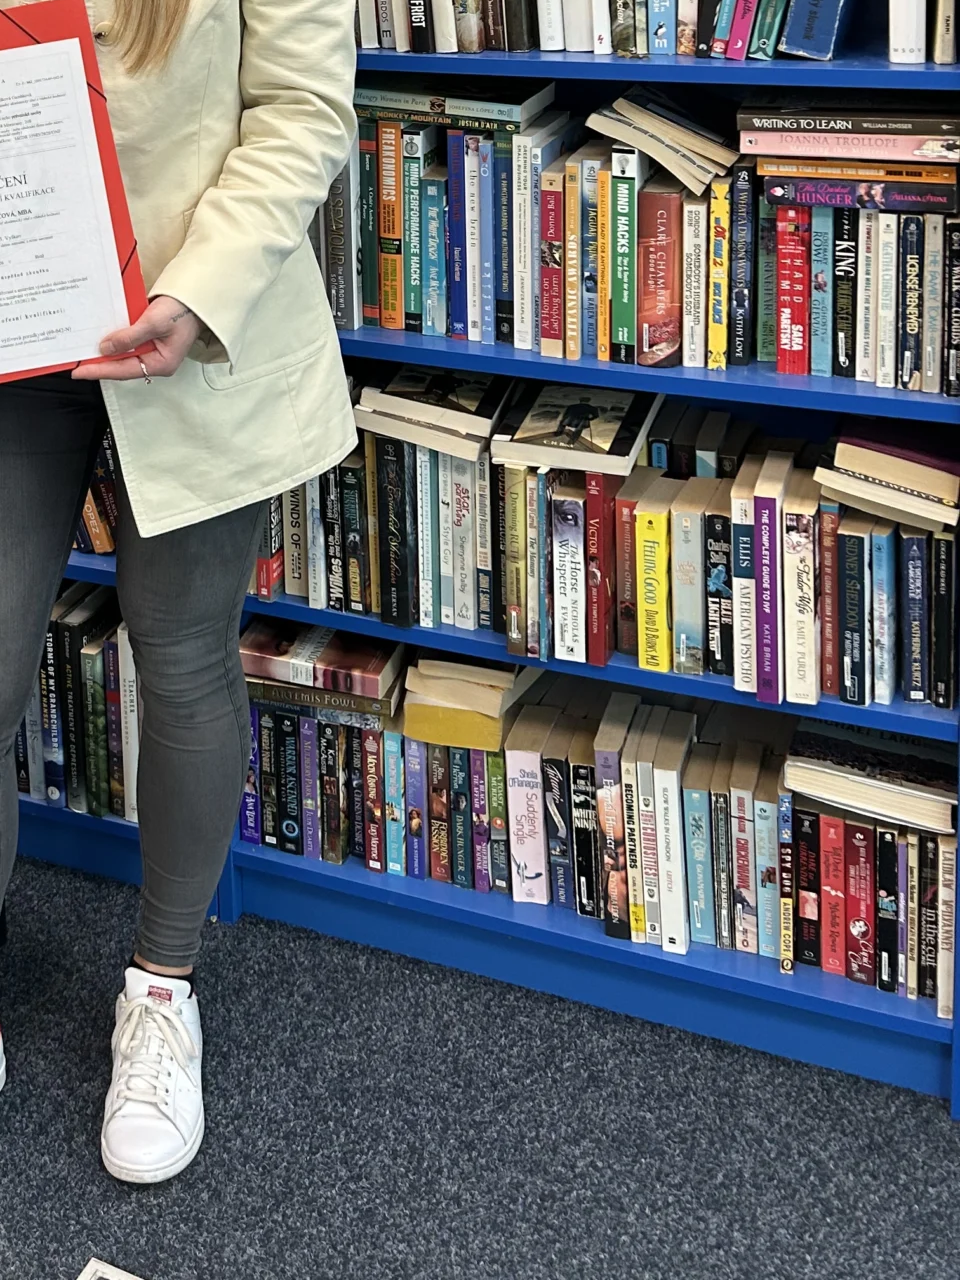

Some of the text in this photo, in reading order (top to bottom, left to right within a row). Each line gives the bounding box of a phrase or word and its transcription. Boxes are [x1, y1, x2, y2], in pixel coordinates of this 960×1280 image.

[377, 112, 451, 124] MONKEY MOUNTAIN
[753, 118, 852, 130] WRITING TO LEARN
[779, 134, 898, 148] JOANNA TROLLOPE
[381, 128, 396, 201] FREAKONOMICS
[5, 187, 55, 201] KVALIFIKACE
[797, 193, 852, 204] HUNGER
[409, 163, 420, 286] MIND PERFORMANCE HACKS
[618, 184, 630, 254] MIND HACKS
[655, 210, 668, 316] CLARE CHAMBERS
[779, 259, 791, 301] TIME
[835, 240, 855, 276] KING
[566, 232, 578, 336] TITANIC AWARDS
[792, 259, 803, 304] HARD
[907, 255, 920, 334] LICENSE RENEWED
[736, 309, 744, 335] KATHY
[780, 308, 791, 351] PARETSKY
[791, 325, 804, 351] SARA
[290, 489, 300, 551] WINDS OF
[588, 519, 600, 554] VICTOR
[557, 539, 581, 597] Horse Whisperer
[644, 540, 660, 578] FEELING
[739, 536, 751, 568] ELLIS
[761, 526, 770, 590] COMPLETE GUIDE
[331, 556, 342, 601] Wilkes
[844, 538, 859, 629] SIDNEY SHELDON
[571, 599, 580, 644] NICHOLAS
[739, 583, 752, 684] AMERICAN PSYCHO
[46, 632, 55, 691] STORMS OF MY
[763, 644, 771, 672] BRIAN
[796, 649, 806, 684] PURDY
[272, 689, 357, 708] ARTEMIS FOWL
[515, 814, 525, 845] Single
[525, 792, 538, 841] Suddenly
[574, 807, 597, 818] WHITE
[574, 818, 597, 831] NINJA
[625, 782, 638, 869] BECOMING PARTNERS
[780, 848, 791, 895] SPY DOG
[782, 902, 791, 953] ANDREW COPE
